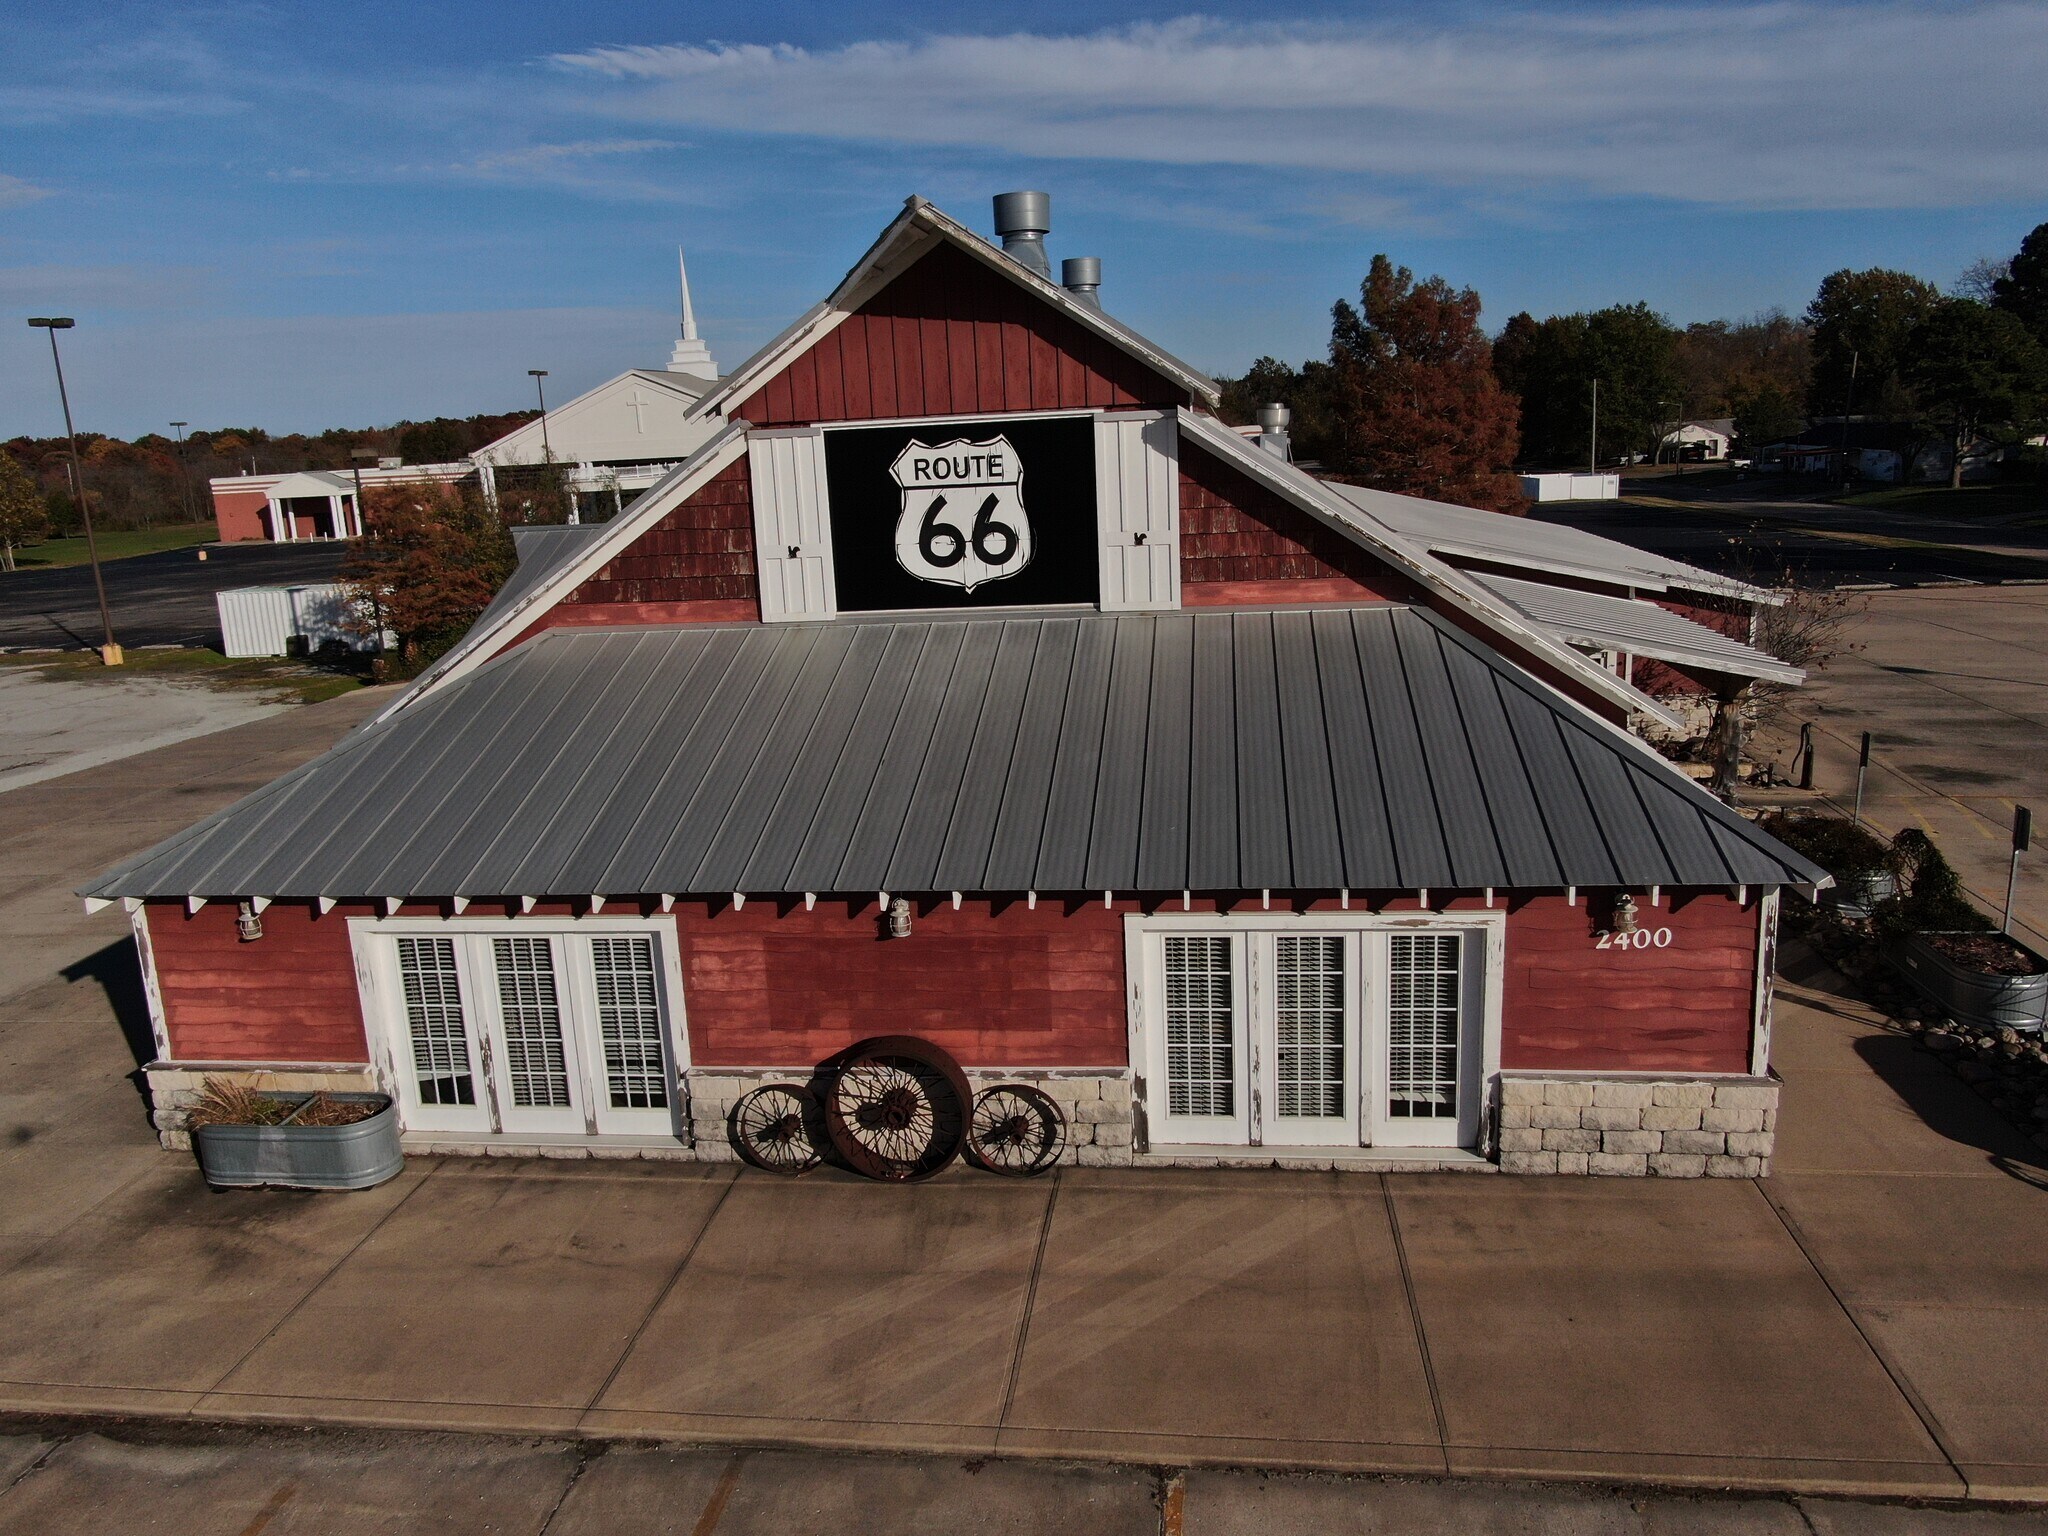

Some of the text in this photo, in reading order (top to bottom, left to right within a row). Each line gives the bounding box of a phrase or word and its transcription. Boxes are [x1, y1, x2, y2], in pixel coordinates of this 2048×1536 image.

[914, 454, 1003, 480] ROUTE
[919, 492, 1017, 568] 66
[1595, 927, 1672, 950] 2400
